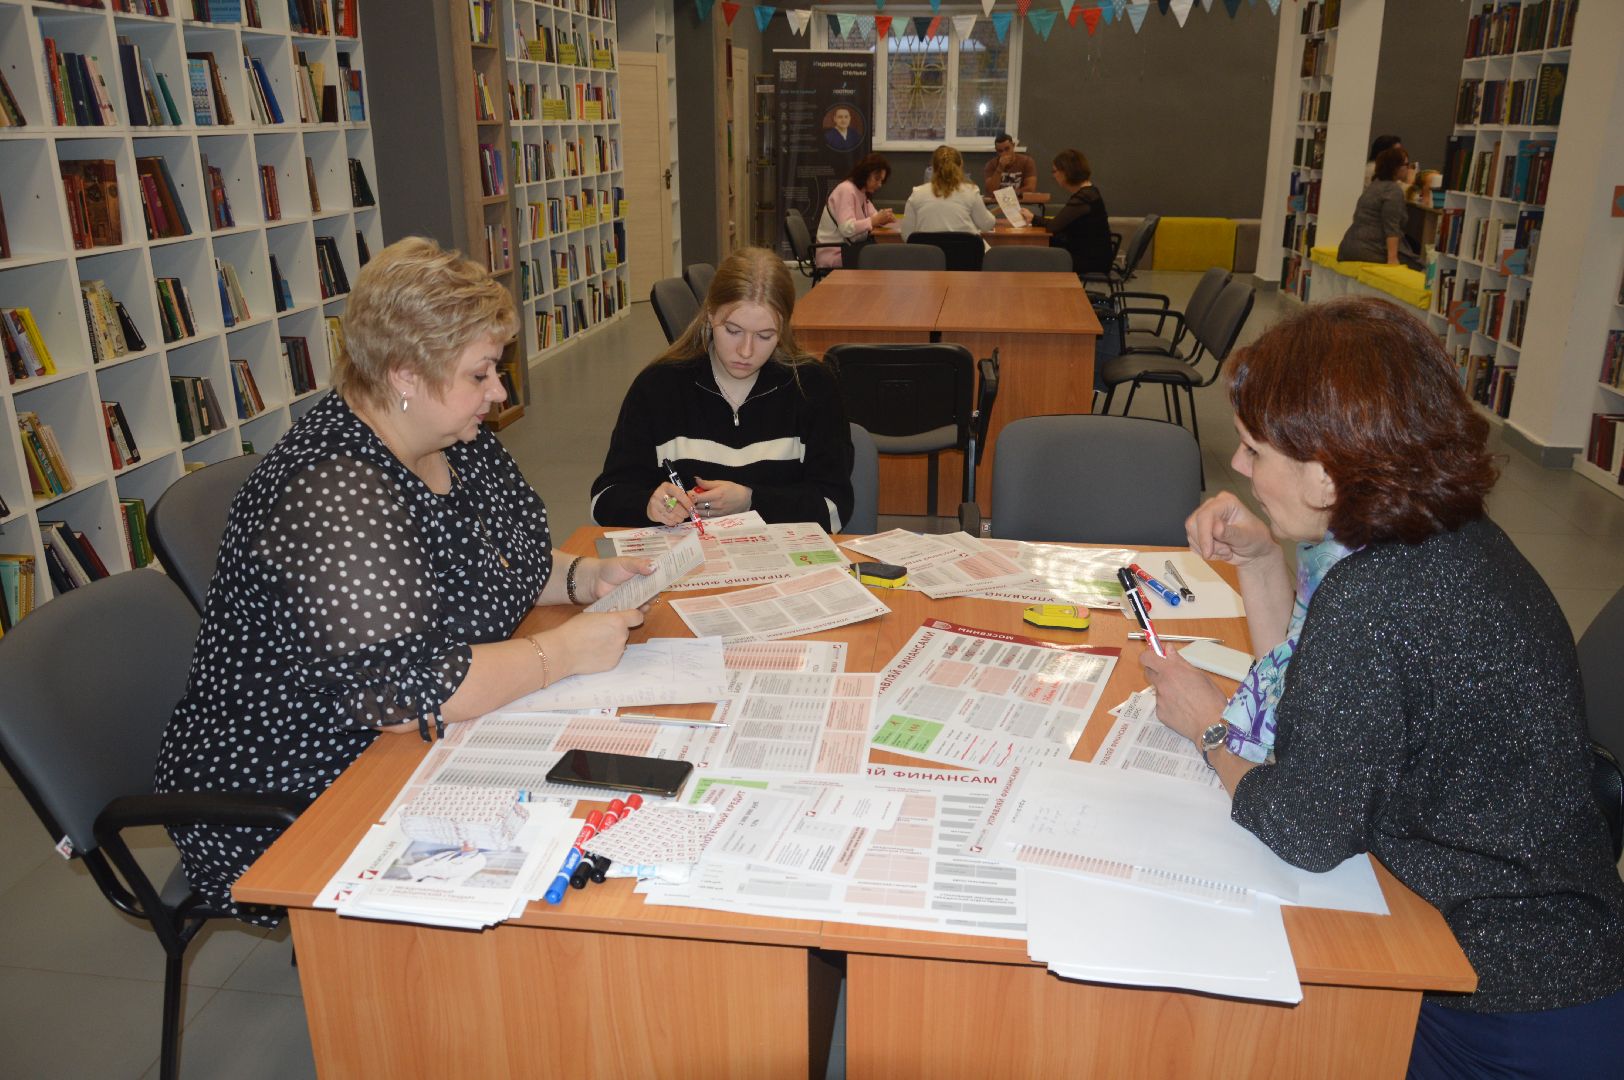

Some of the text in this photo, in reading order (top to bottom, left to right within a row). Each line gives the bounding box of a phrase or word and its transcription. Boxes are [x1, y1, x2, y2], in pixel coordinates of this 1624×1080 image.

[724, 573, 791, 585] УПРАВЛЯЙ
[984, 591, 1055, 603] УПРАВЛЯЙ
[957, 626, 1015, 641] МОСКВИНЫ
[899, 630, 936, 669] ФИНАНСАМИ
[893, 772, 998, 785] ФИНАНСАМ
[1002, 766, 1021, 799] ФИНАНСАМИ
